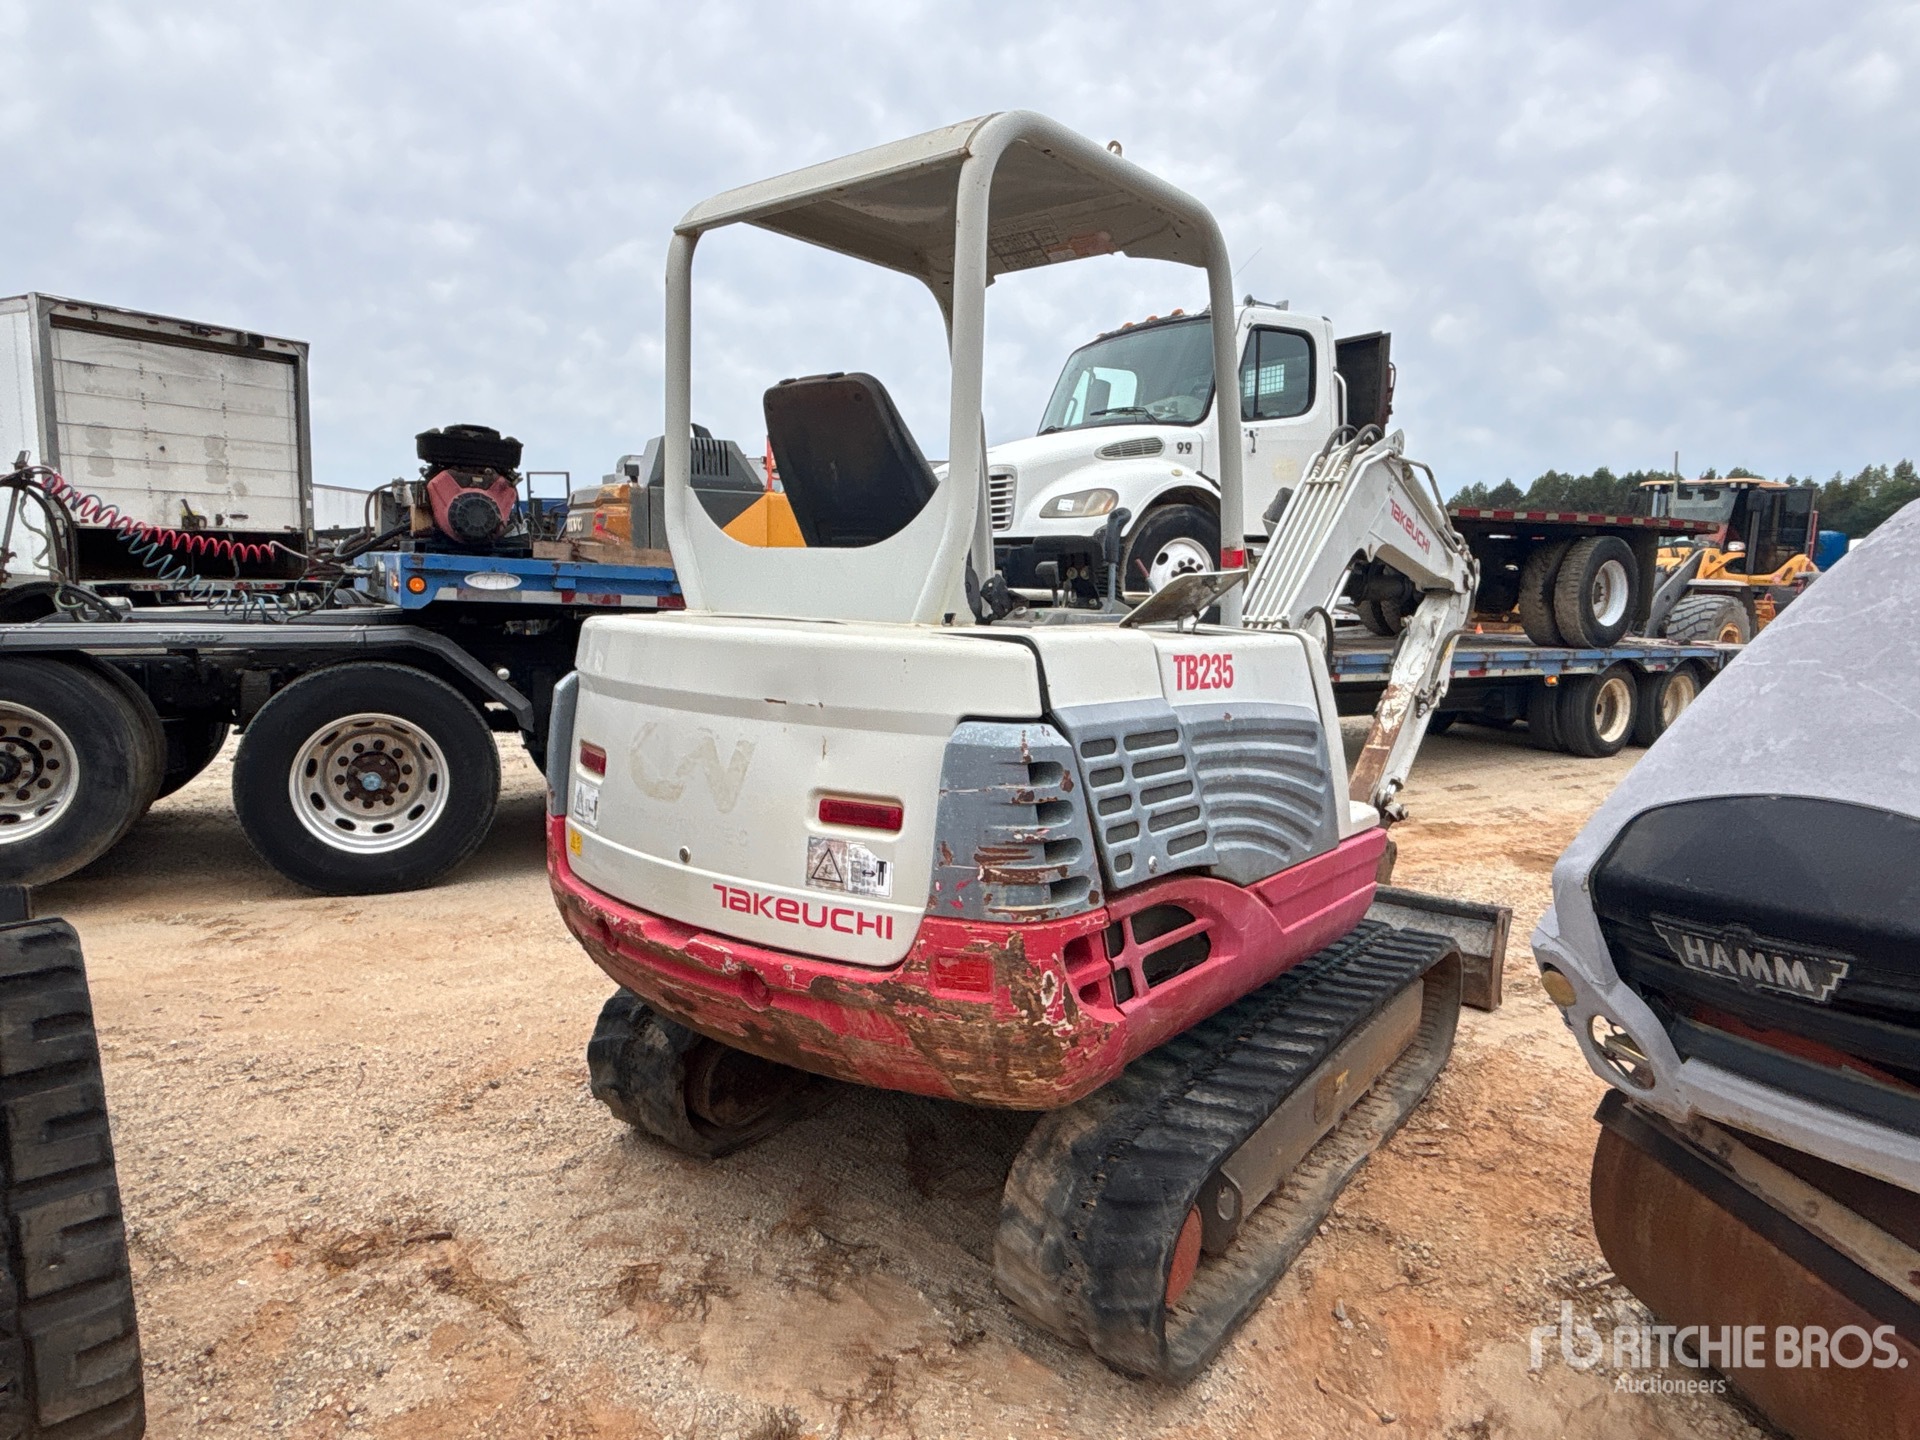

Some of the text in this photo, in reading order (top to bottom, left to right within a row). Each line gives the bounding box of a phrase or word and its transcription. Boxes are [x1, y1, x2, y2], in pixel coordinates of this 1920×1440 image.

[1176, 442, 1192, 454] 99
[1173, 653, 1234, 691] TB235
[1682, 935, 1814, 992] HAMM
